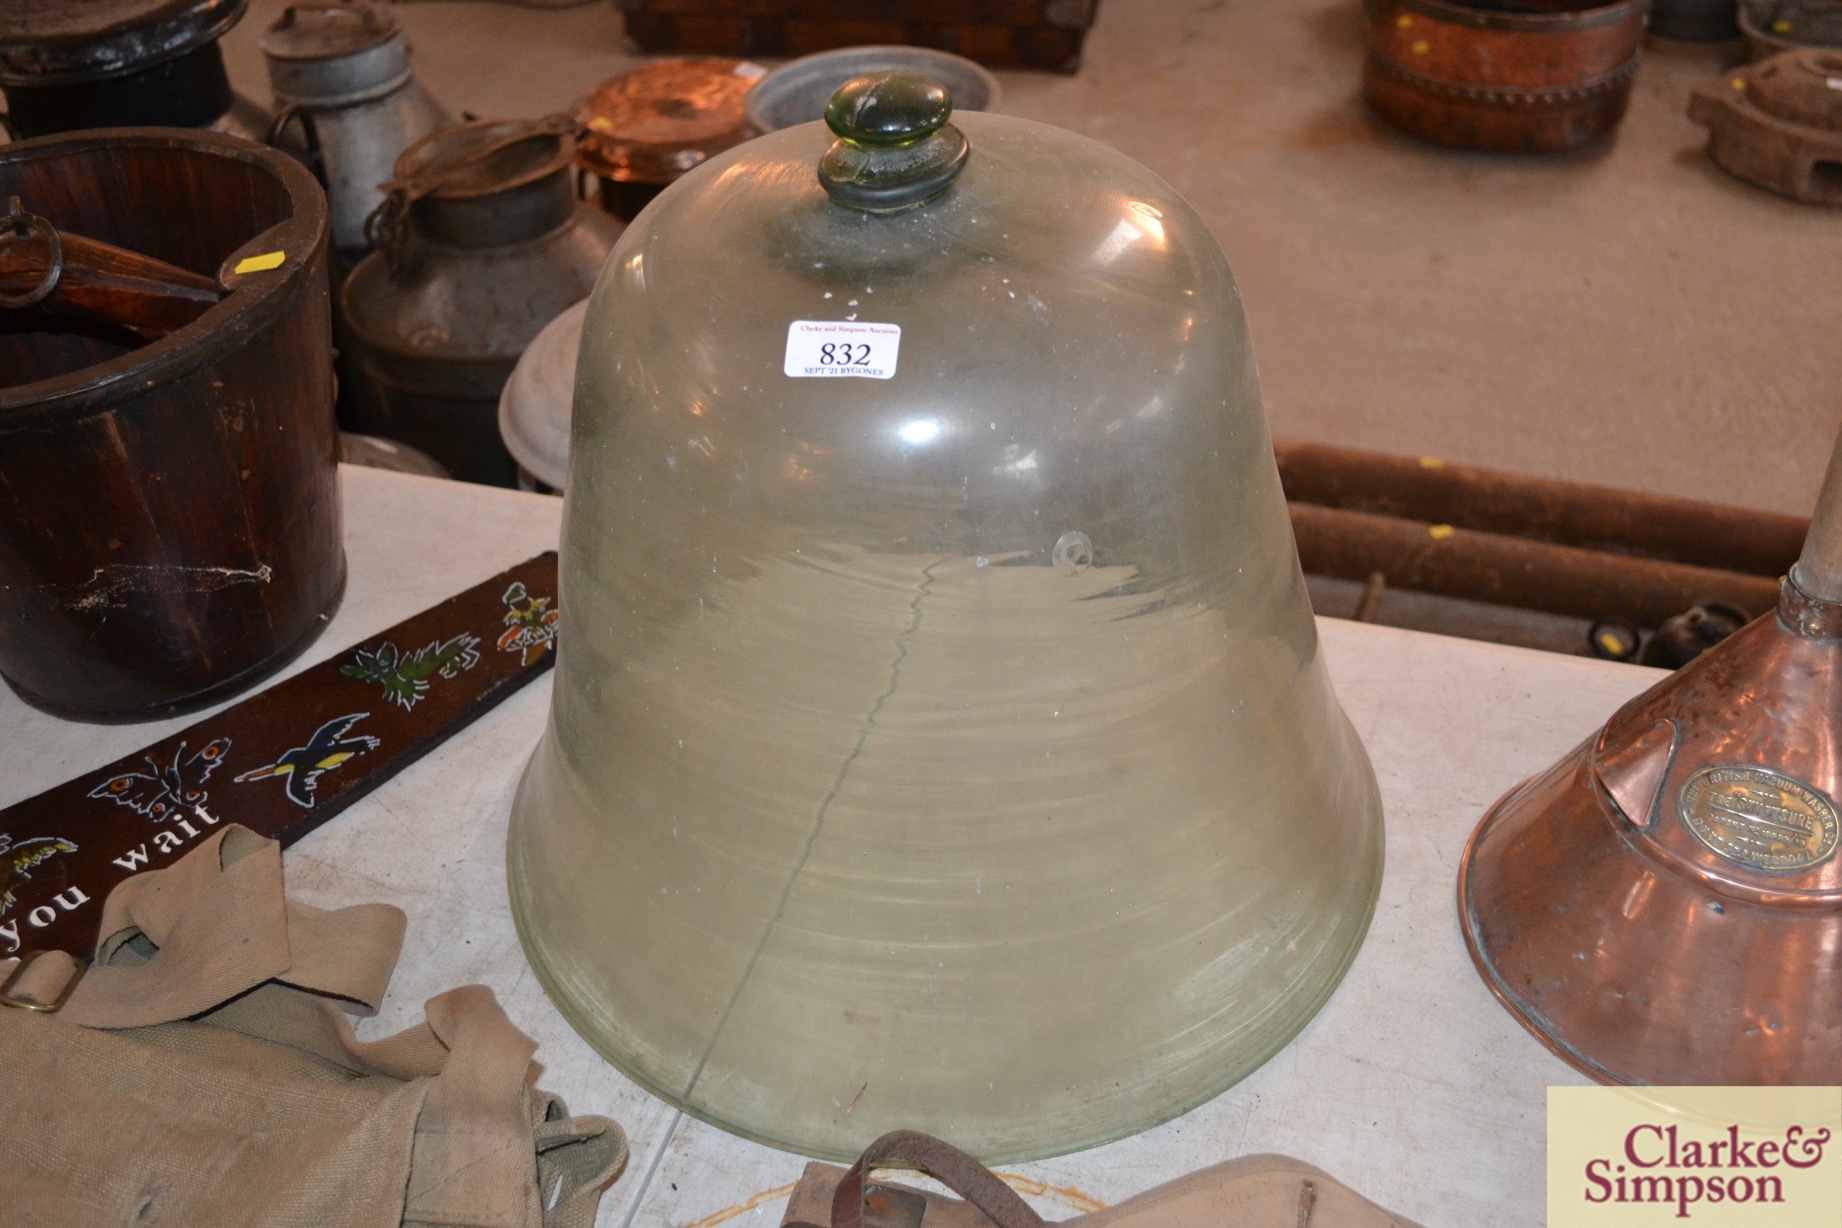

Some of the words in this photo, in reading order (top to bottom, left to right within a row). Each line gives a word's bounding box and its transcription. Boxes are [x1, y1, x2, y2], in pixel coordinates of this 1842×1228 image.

[838, 326, 867, 334] Simpson
[868, 327, 899, 335] Auctions
[820, 342, 871, 366] 832
[804, 367, 827, 375] SEPT
[828, 367, 838, 375] '21
[840, 367, 884, 376] BYGONES
[1701, 771, 1750, 788] BRITISH
[1754, 773, 1801, 797] VACUUM
[1802, 791, 1834, 830] WASHER
[1708, 790, 1733, 807] THE
[1741, 849, 1813, 866] LIVERPOOL
[0, 885, 91, 953] you
[112, 804, 219, 872] wait
